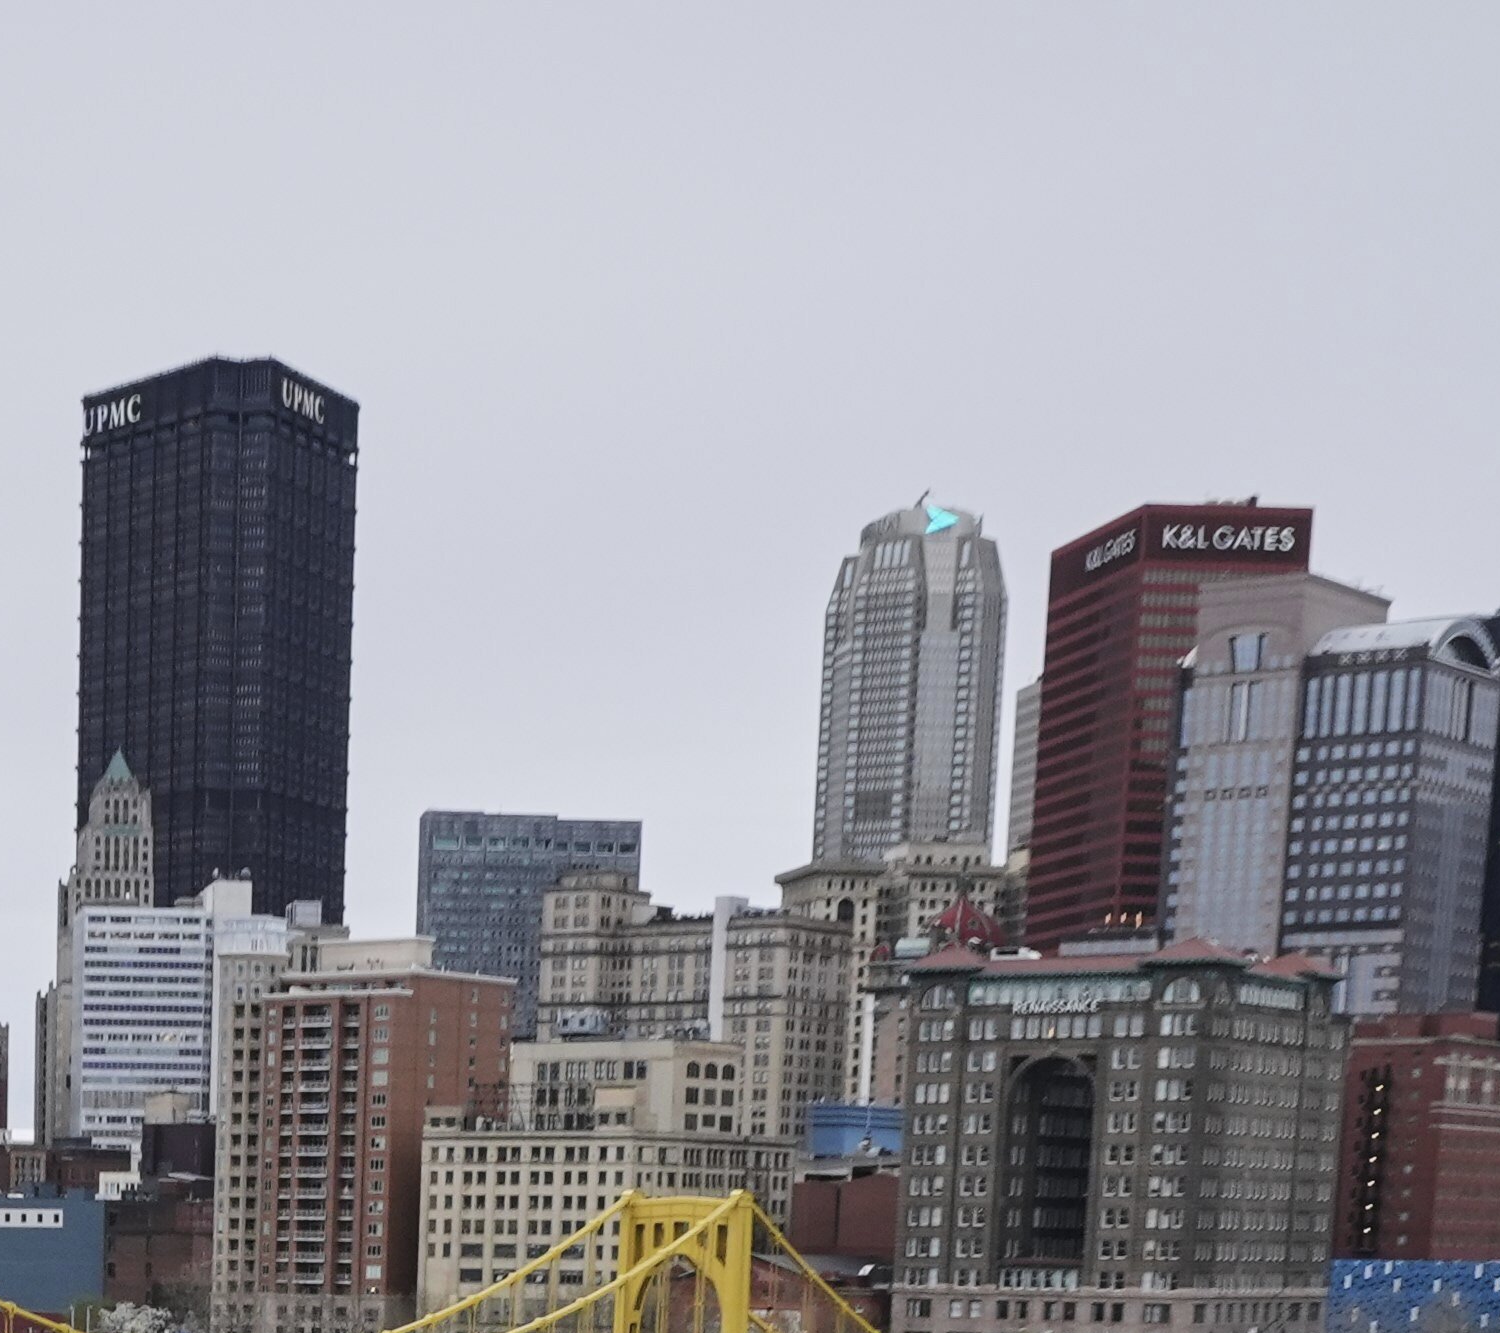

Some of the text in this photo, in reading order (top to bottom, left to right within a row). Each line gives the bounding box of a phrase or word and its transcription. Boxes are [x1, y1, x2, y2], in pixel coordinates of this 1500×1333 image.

[83, 393, 142, 437] UPMC
[282, 378, 326, 425] UPMC
[1161, 525, 1296, 554] K&L GATES
[1012, 997, 1101, 1016] RENAISSANCE
